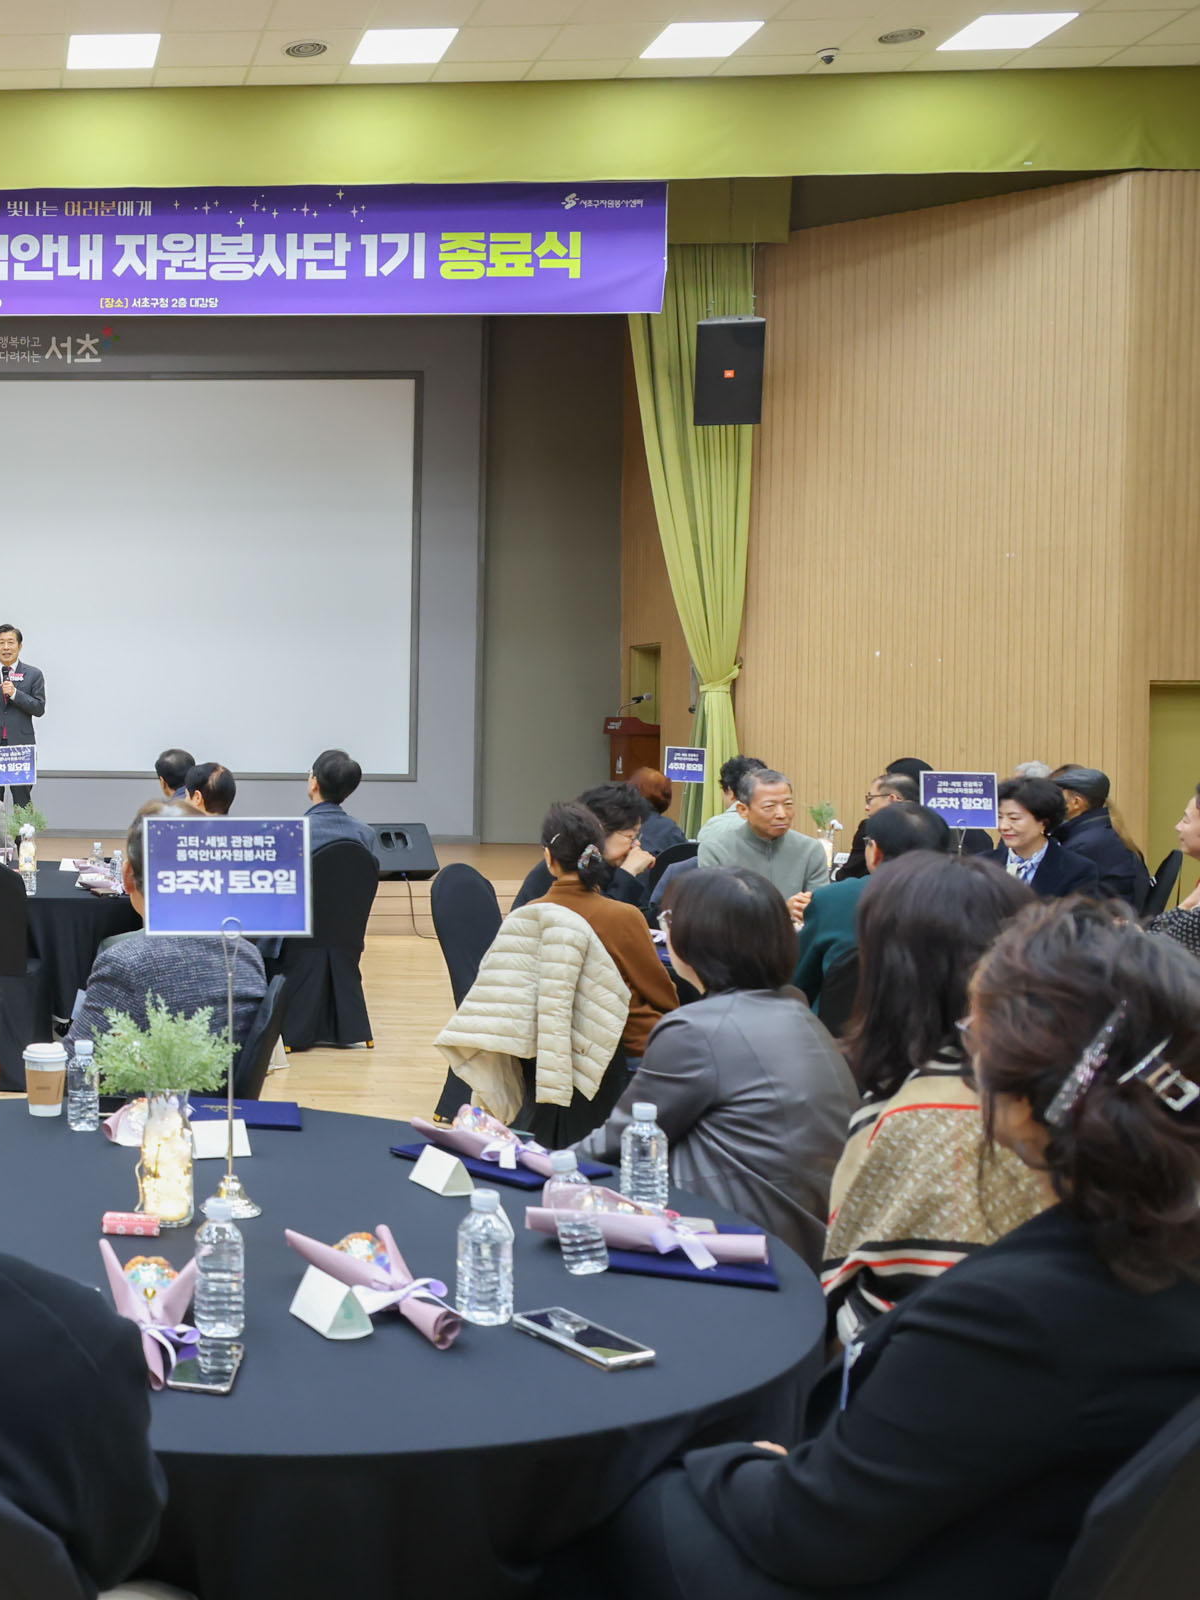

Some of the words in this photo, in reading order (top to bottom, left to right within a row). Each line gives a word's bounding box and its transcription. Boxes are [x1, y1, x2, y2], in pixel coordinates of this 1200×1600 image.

[7, 200, 59, 217] 빛나는
[64, 200, 152, 217] 여러분에게
[112, 232, 351, 281] 자원봉사단
[359, 232, 426, 280] 1기
[438, 231, 583, 280] 종료식
[100, 298, 129, 309] [장소]
[132, 297, 169, 309] 서초구청
[171, 297, 188, 309] 2층
[190, 297, 219, 309] 대강당
[44, 333, 102, 364] 서초
[927, 797, 960, 810] 4주차
[961, 797, 993, 810] 일요일
[176, 835, 228, 848] 고터·세빛
[230, 835, 276, 848] 관광특구
[176, 848, 277, 862] 통역안내자원봉사단
[157, 869, 225, 895] 3주차
[227, 869, 297, 895] 토요일
